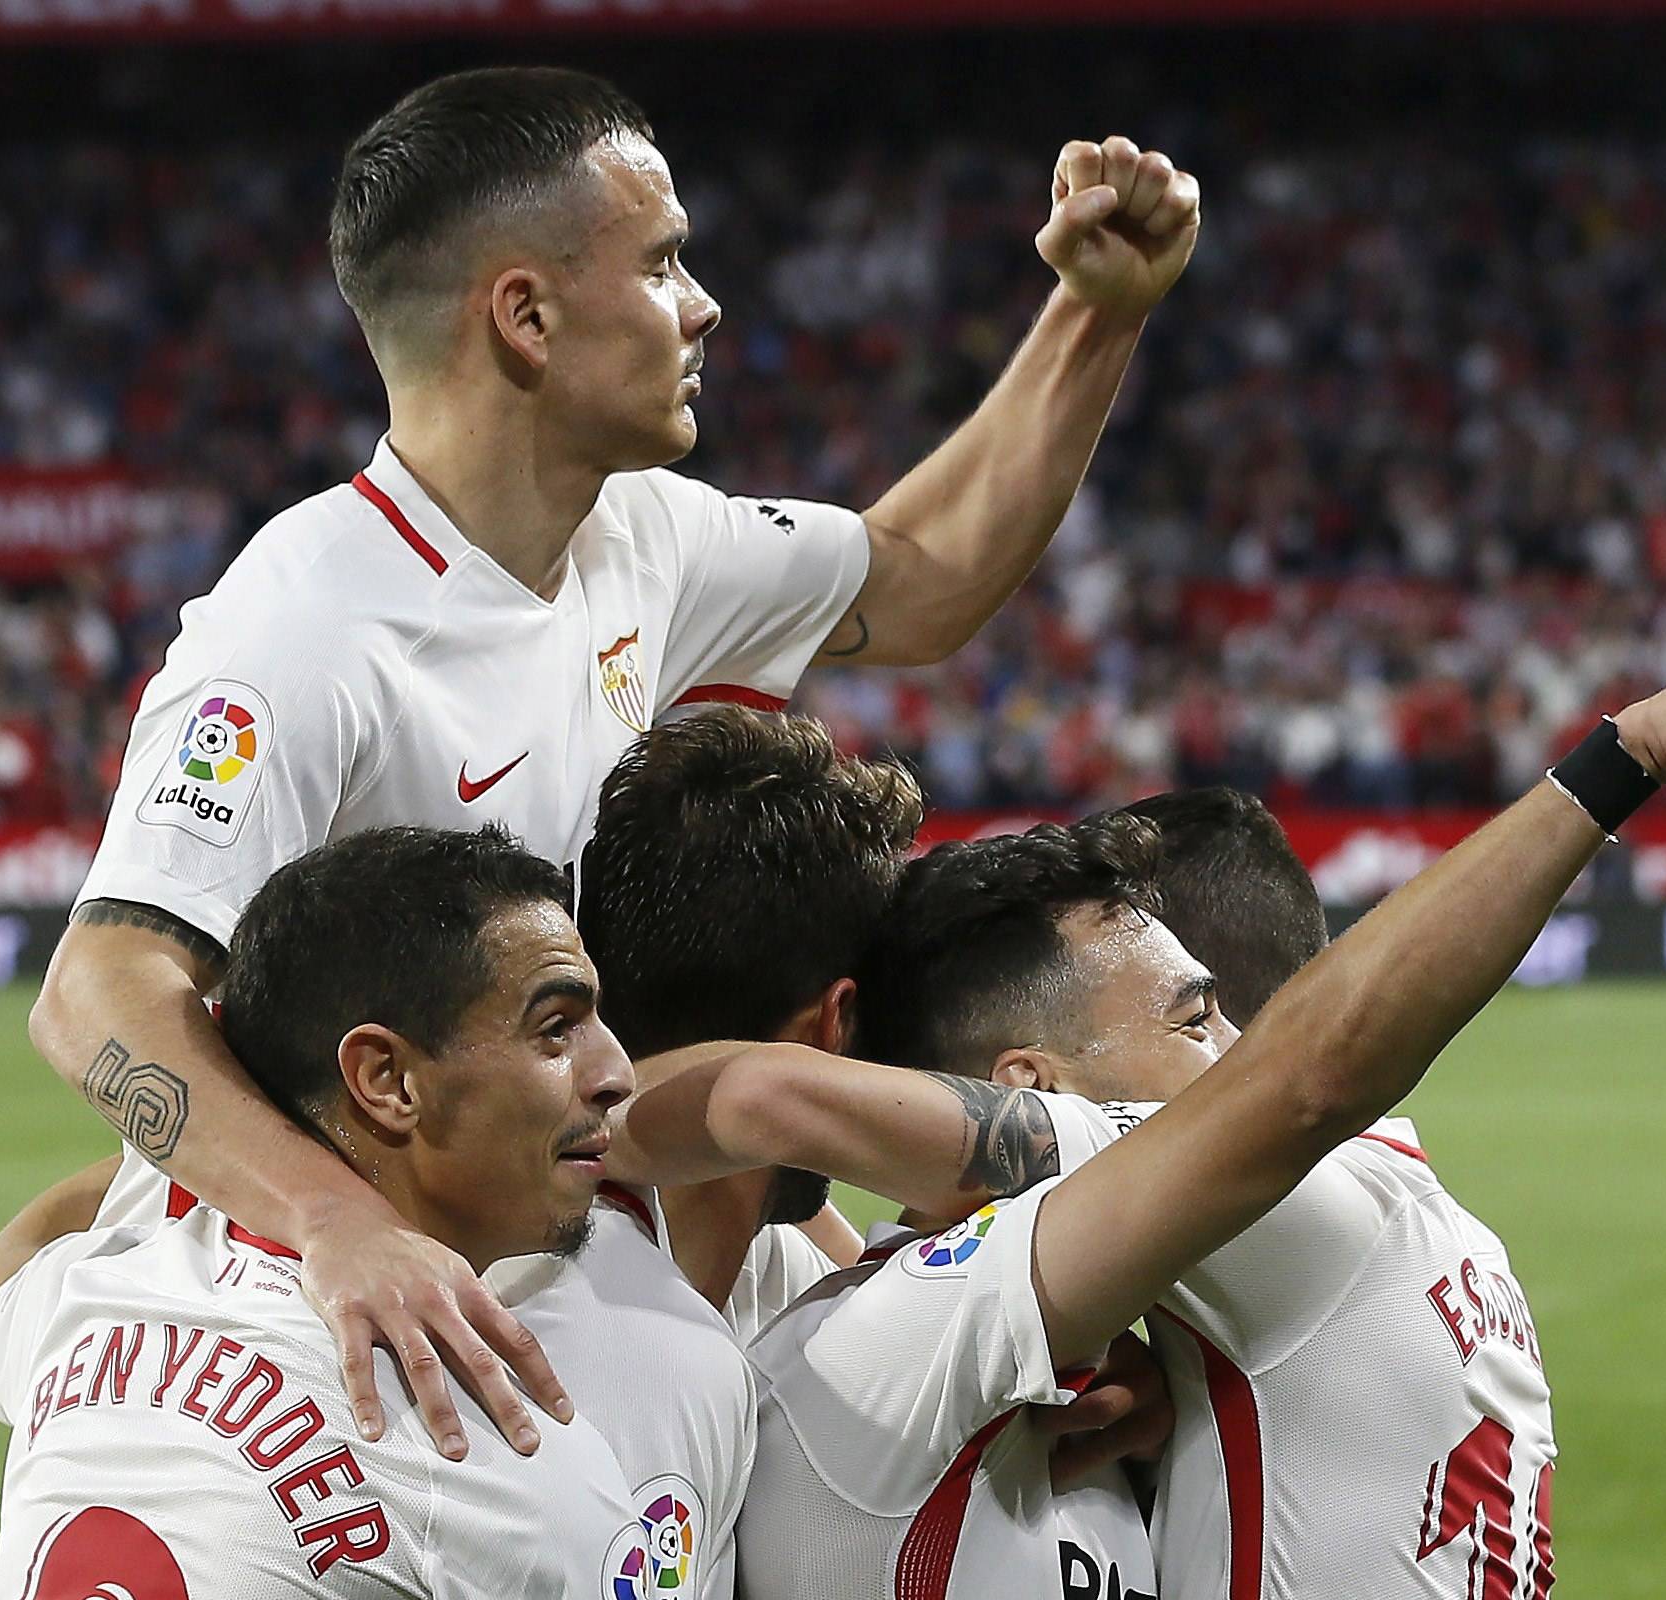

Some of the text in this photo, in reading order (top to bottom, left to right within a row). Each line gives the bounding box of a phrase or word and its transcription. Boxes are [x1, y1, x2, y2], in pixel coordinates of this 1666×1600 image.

[154, 784, 234, 825] LaLiga
[27, 1322, 391, 1581] BEN YEDDER
